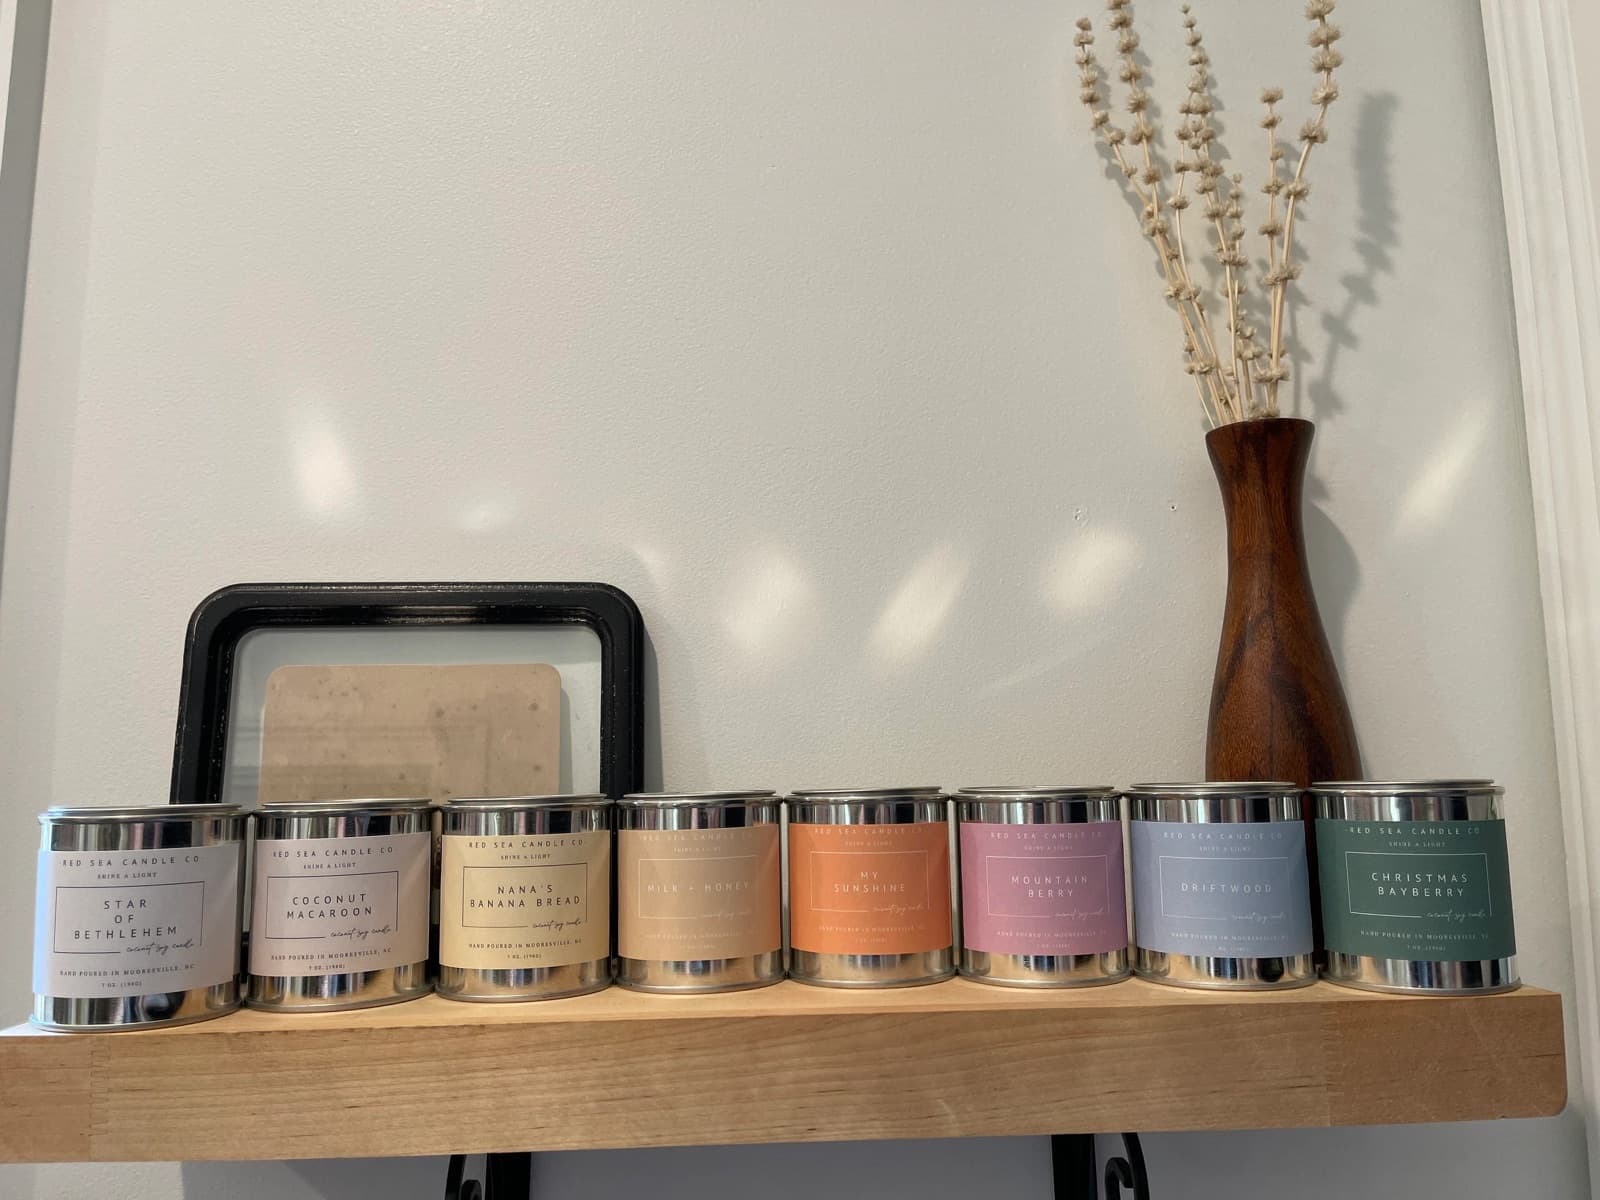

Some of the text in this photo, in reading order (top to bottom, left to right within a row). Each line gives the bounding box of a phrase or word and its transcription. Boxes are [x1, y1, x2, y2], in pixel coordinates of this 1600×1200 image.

[864, 827, 906, 835] CANDLE
[990, 832, 1009, 840] RED
[1017, 832, 1037, 840] SEA
[1163, 831, 1184, 839] RED
[1191, 832, 1211, 840] SEA
[1220, 832, 1265, 840] CANDLE
[1350, 827, 1481, 836] RED SEA CANDLE CO
[521, 839, 565, 848] CANDLE
[296, 850, 317, 858] SEA
[324, 847, 372, 857] CANDLE
[380, 846, 394, 854] CO
[62, 855, 200, 867] RED SEA CANDLE CO
[132, 871, 158, 879] LIGHT
[860, 871, 879, 880] MY
[1010, 875, 1088, 886] MOUNTAIN
[1371, 872, 1469, 884] CHRISTMAS
[497, 884, 553, 895] NANA'S
[647, 884, 679, 894] MILK
[704, 881, 750, 893] HONEY
[834, 883, 906, 894] SUNSHINE
[1180, 882, 1273, 894] DRIFTWOOD
[1378, 886, 1465, 898] BAYBERRY
[1028, 889, 1074, 898] BERRY
[103, 899, 149, 910] STAR
[292, 893, 368, 906] COCONUT
[470, 895, 581, 909] BANANA BREAD
[286, 907, 373, 920] MACAROON
[114, 914, 135, 925] OF
[73, 925, 178, 940] BETHLEHEM
